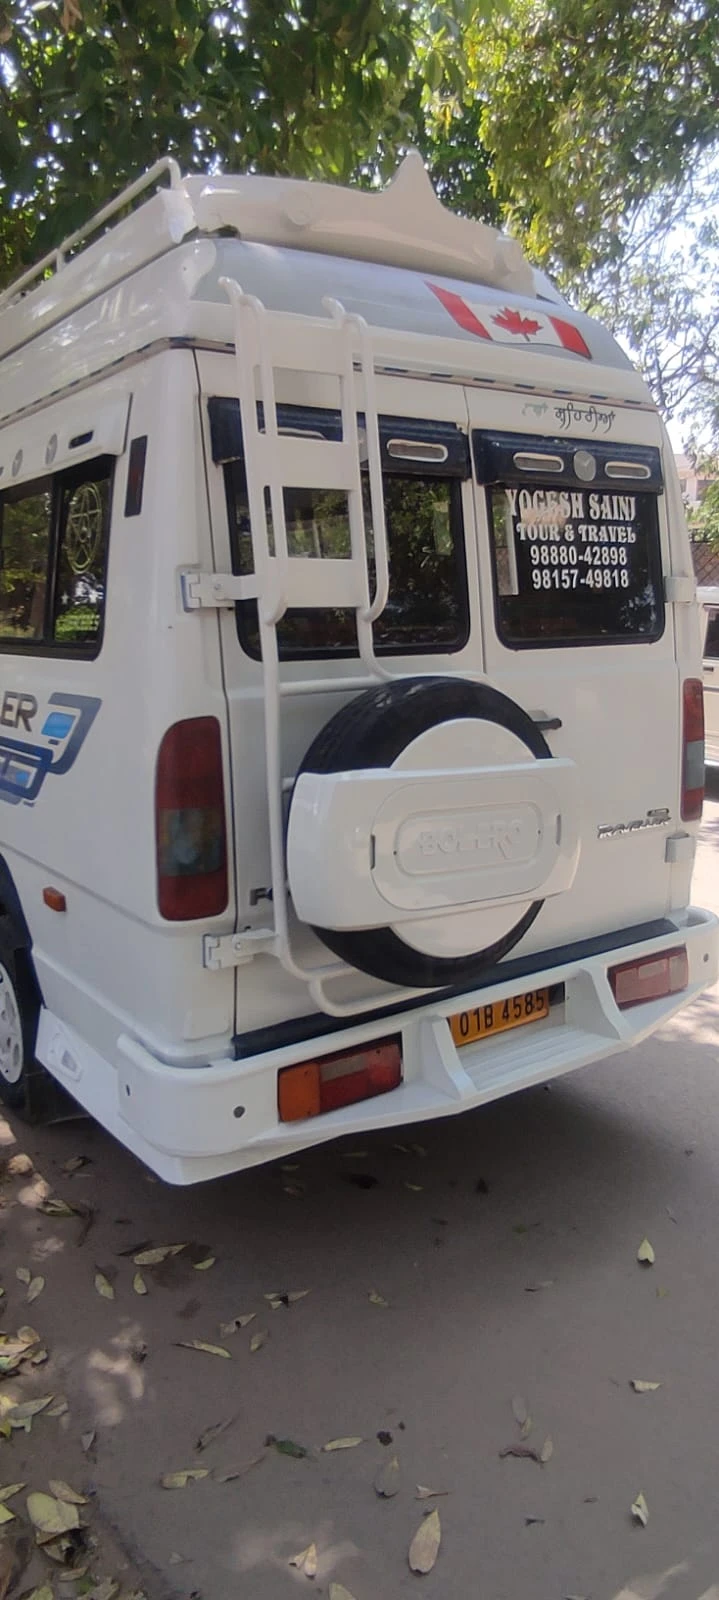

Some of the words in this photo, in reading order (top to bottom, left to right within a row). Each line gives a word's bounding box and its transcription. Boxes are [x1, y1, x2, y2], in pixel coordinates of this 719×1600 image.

[505, 489, 584, 519] YOGESH
[589, 493, 636, 521] SAINI
[516, 522, 560, 542] TOUR
[564, 524, 574, 542] &
[578, 525, 636, 544] TRAVEL
[530, 545, 627, 566] 98880-42898
[532, 569, 629, 589] 98157-49818
[501, 988, 545, 1020] 4585
